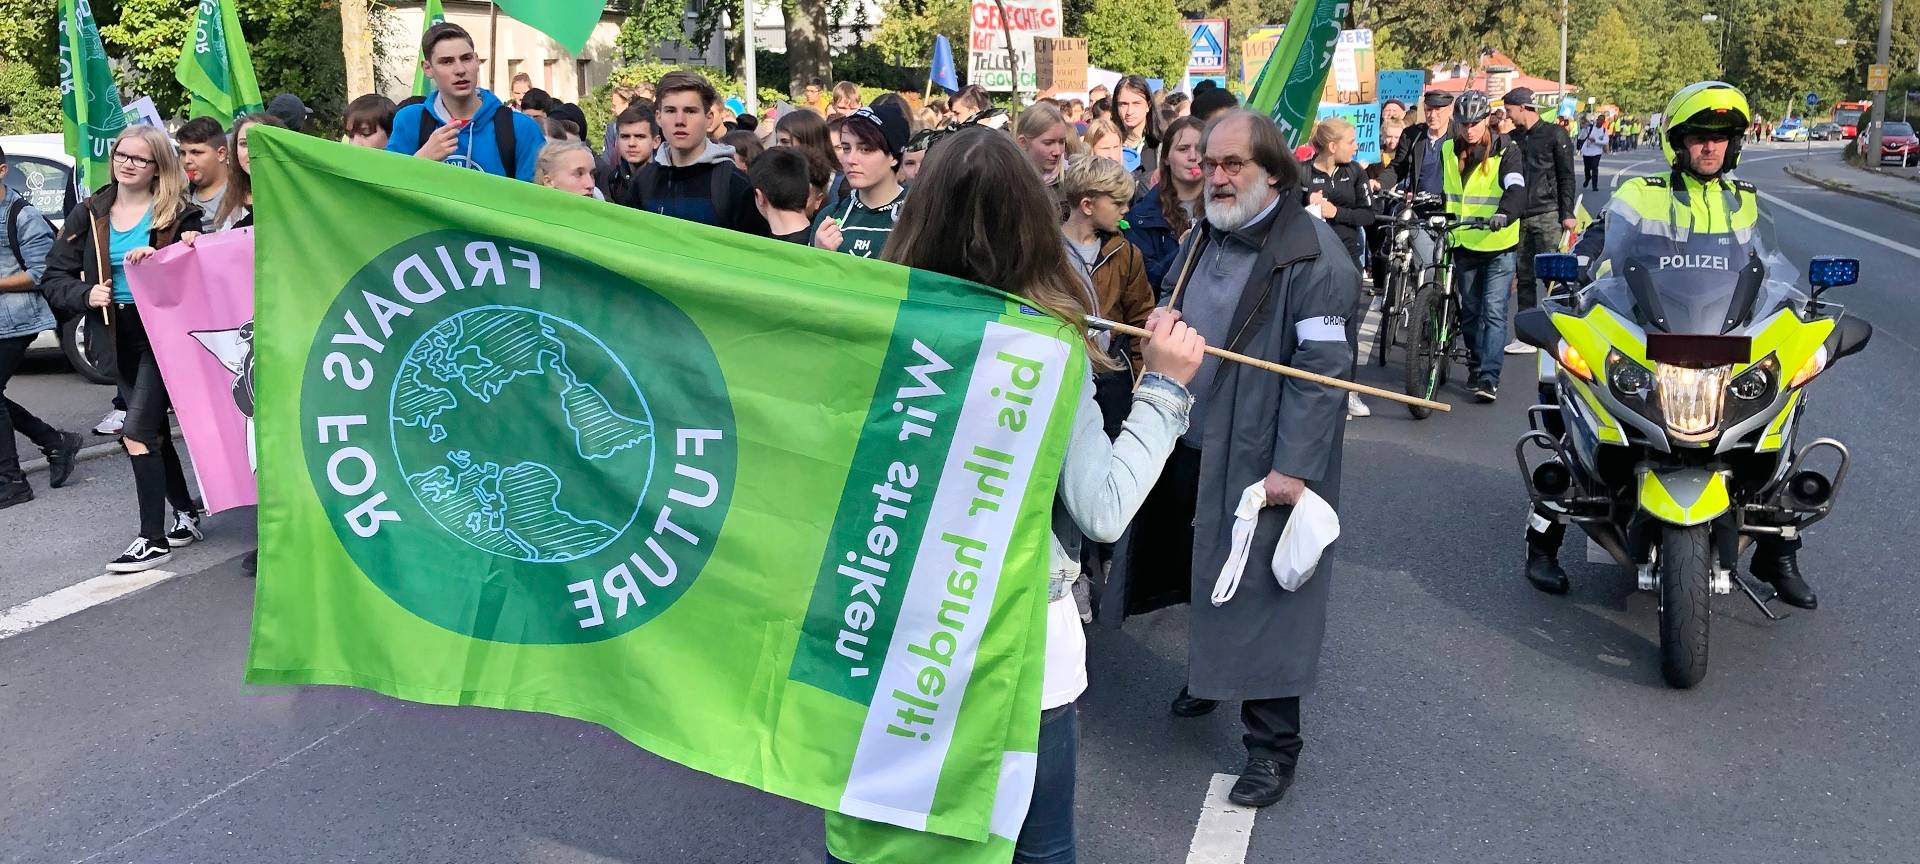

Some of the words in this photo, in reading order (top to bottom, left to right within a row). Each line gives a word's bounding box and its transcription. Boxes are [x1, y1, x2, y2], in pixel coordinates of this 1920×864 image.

[1339, 29, 1371, 45] SERE
[1051, 40, 1072, 51] WILL
[1188, 56, 1222, 66] ALDI
[1354, 108, 1376, 123] the
[1357, 125, 1373, 138] TH
[854, 239, 871, 251] RH
[1660, 254, 1729, 271] POLIZEI
